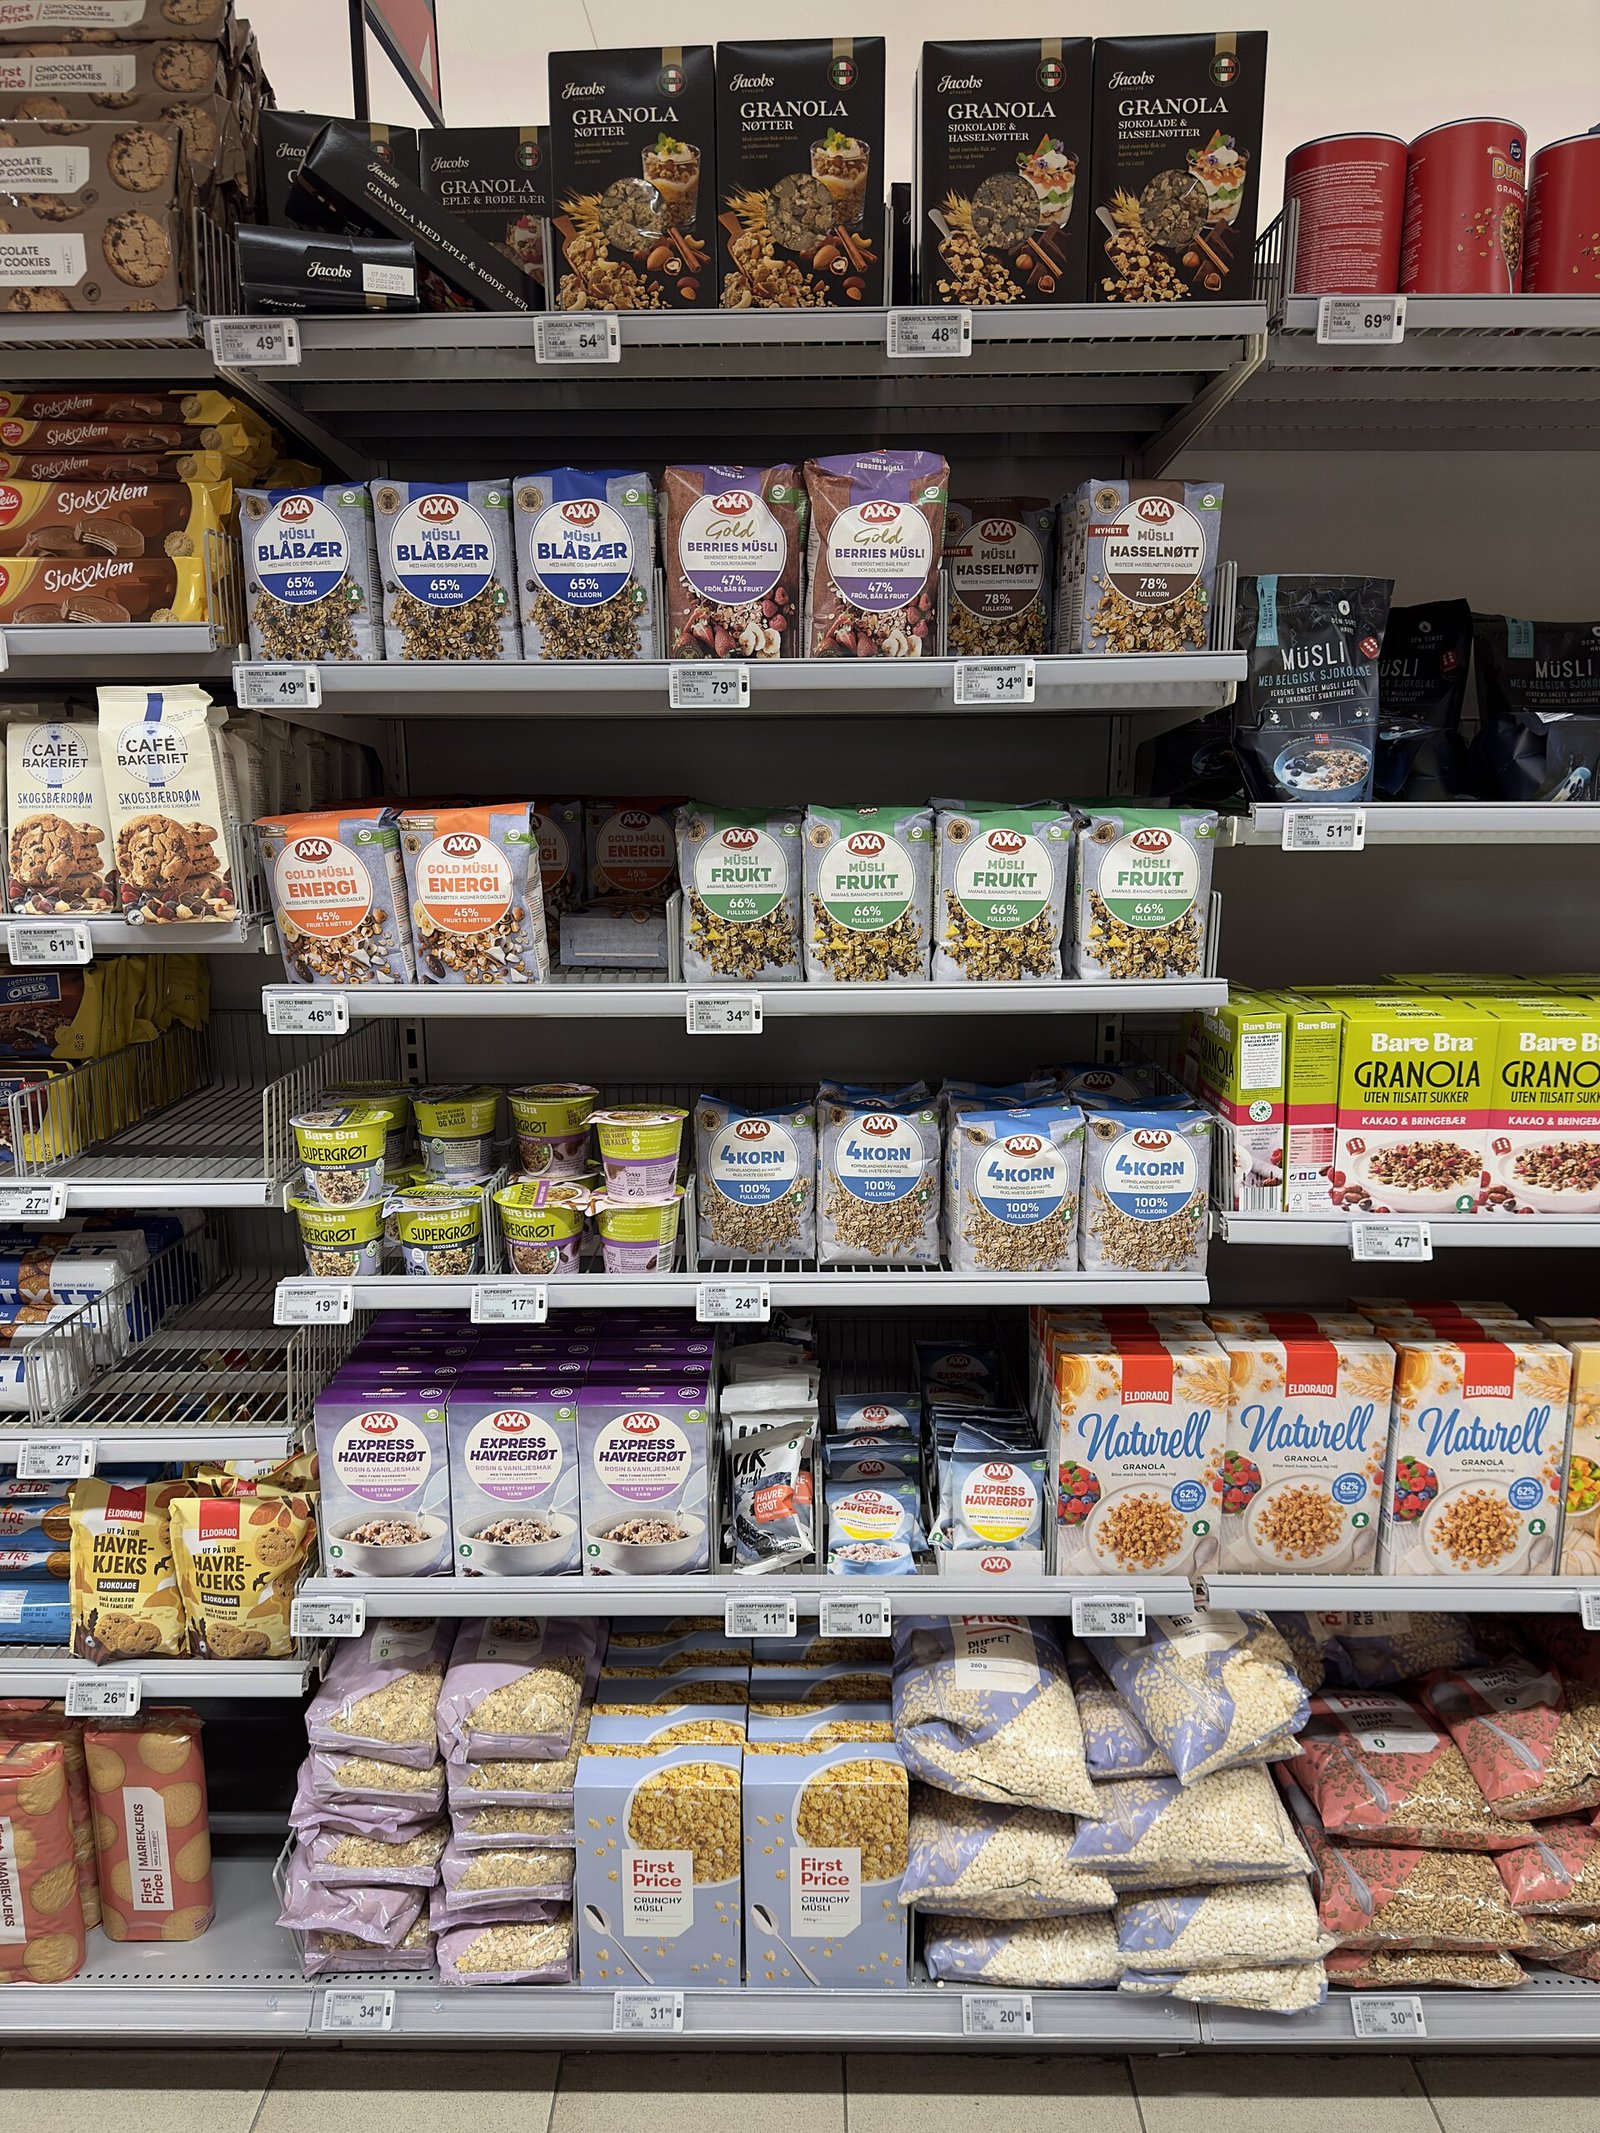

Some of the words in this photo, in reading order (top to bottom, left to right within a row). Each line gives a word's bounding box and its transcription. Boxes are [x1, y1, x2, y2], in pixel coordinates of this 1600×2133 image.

[36, 64, 93, 72] CHOCOLATE
[35, 73, 57, 81] CHIP
[938, 75, 983, 92] Jacobs
[562, 82, 605, 98] Jacobs
[572, 106, 678, 124] GRANOLA
[948, 102, 1055, 119] GRANOLA
[574, 126, 624, 138] NØTTER
[948, 123, 1005, 132] SJOKOLADE
[1008, 123, 1016, 131] &
[948, 132, 1029, 142] HASSELNØTTER
[431, 157, 469, 172] Jacobs
[367, 162, 399, 190] Jacobs
[441, 179, 535, 194] GRANOLA
[442, 197, 470, 205] EPLE
[485, 196, 516, 204] RØDE
[520, 195, 545, 204] BÆR
[367, 182, 414, 223] GRANOLA
[416, 220, 440, 242] MED
[441, 240, 467, 263] EPLE
[468, 261, 476, 270] &
[477, 268, 505, 292] RØDE
[506, 290, 529, 312] BÆR
[307, 262, 351, 279] Jacobs
[566, 504, 597, 518] AXA
[864, 504, 897, 518] AXA
[1141, 501, 1171, 516] AXA
[563, 530, 601, 542] MÜSLI
[854, 527, 904, 545] Gold
[1138, 529, 1174, 541] MÜSLI
[538, 541, 628, 560] BLÅBÆR
[835, 549, 887, 558] BERRIES
[890, 547, 924, 558] MÜSLI
[1110, 545, 1199, 558] HASSELNØTT
[570, 579, 599, 589] 65%
[868, 582, 892, 592] 47%
[1140, 578, 1167, 589] 78%
[1258, 675, 1273, 687] MED
[1276, 671, 1316, 683] BELGISK
[1320, 666, 1372, 680] SJOKOLADE
[1296, 686, 1318, 695] ENESTE
[1341, 680, 1360, 689] LAGET
[126, 736, 176, 752] CAFÉ
[118, 753, 188, 766] BAKERIET
[119, 790, 200, 805] SKOGSBÆRDRØM
[446, 835, 478, 851] AXA
[1137, 832, 1168, 846] AXA
[427, 864, 459, 874] GOLD
[463, 861, 498, 874] MÜSLI
[1132, 857, 1170, 868] MÜSLI
[429, 878, 499, 893] ENERGI
[1118, 871, 1184, 886] FRUKT
[454, 907, 478, 917] 45%
[1135, 903, 1163, 914] 66%
[9, 983, 48, 999] OREO
[1371, 1033, 1429, 1052] Bare
[1433, 1034, 1474, 1052] Bra
[1354, 1061, 1481, 1088] GRANOLA
[1364, 1092, 1389, 1103] UTEN
[1392, 1091, 1426, 1103] TILSATT
[1430, 1091, 1468, 1103] SUKKER
[1362, 1116, 1397, 1126] KAKAO
[1400, 1117, 1409, 1125] &
[1411, 1116, 1466, 1126] BRINGEBÆR
[304, 1129, 333, 1140] Bare
[336, 1130, 358, 1140] Bra
[737, 1122, 767, 1136] AXA
[302, 1145, 367, 1161] SUPERGRØT
[739, 1184, 770, 1193] 100%
[1466, 1385, 1510, 1397] ELDORADO
[365, 1414, 395, 1430] AXA
[1417, 1405, 1550, 1457] Naturell
[347, 1439, 414, 1450] EXPRESS
[338, 1452, 426, 1463] HAVREGRØT
[987, 1464, 1010, 1476] AXA
[757, 1489, 786, 1504] HAVRE-
[974, 1485, 1025, 1495] EXPRESS
[1517, 1486, 1535, 1496] 62%
[757, 1500, 778, 1512] GRØT
[966, 1496, 1034, 1507] HAVREGRØT
[107, 1507, 143, 1520] ELDORADO
[117, 1526, 125, 1535] PÅ
[93, 1535, 154, 1554] HAVRE-
[92, 1556, 147, 1574] KJEKS
[984, 1559, 1008, 1569] AXA
[99, 1581, 137, 1590] SJOKOLADE
[134, 1804, 148, 1866] MARIEKJEKS
[801, 1858, 843, 1872] First
[801, 1872, 849, 1887] Price
[141, 1878, 152, 1904] First
[153, 1874, 164, 1904] Price
[801, 1902, 831, 1912] MÜSLI
